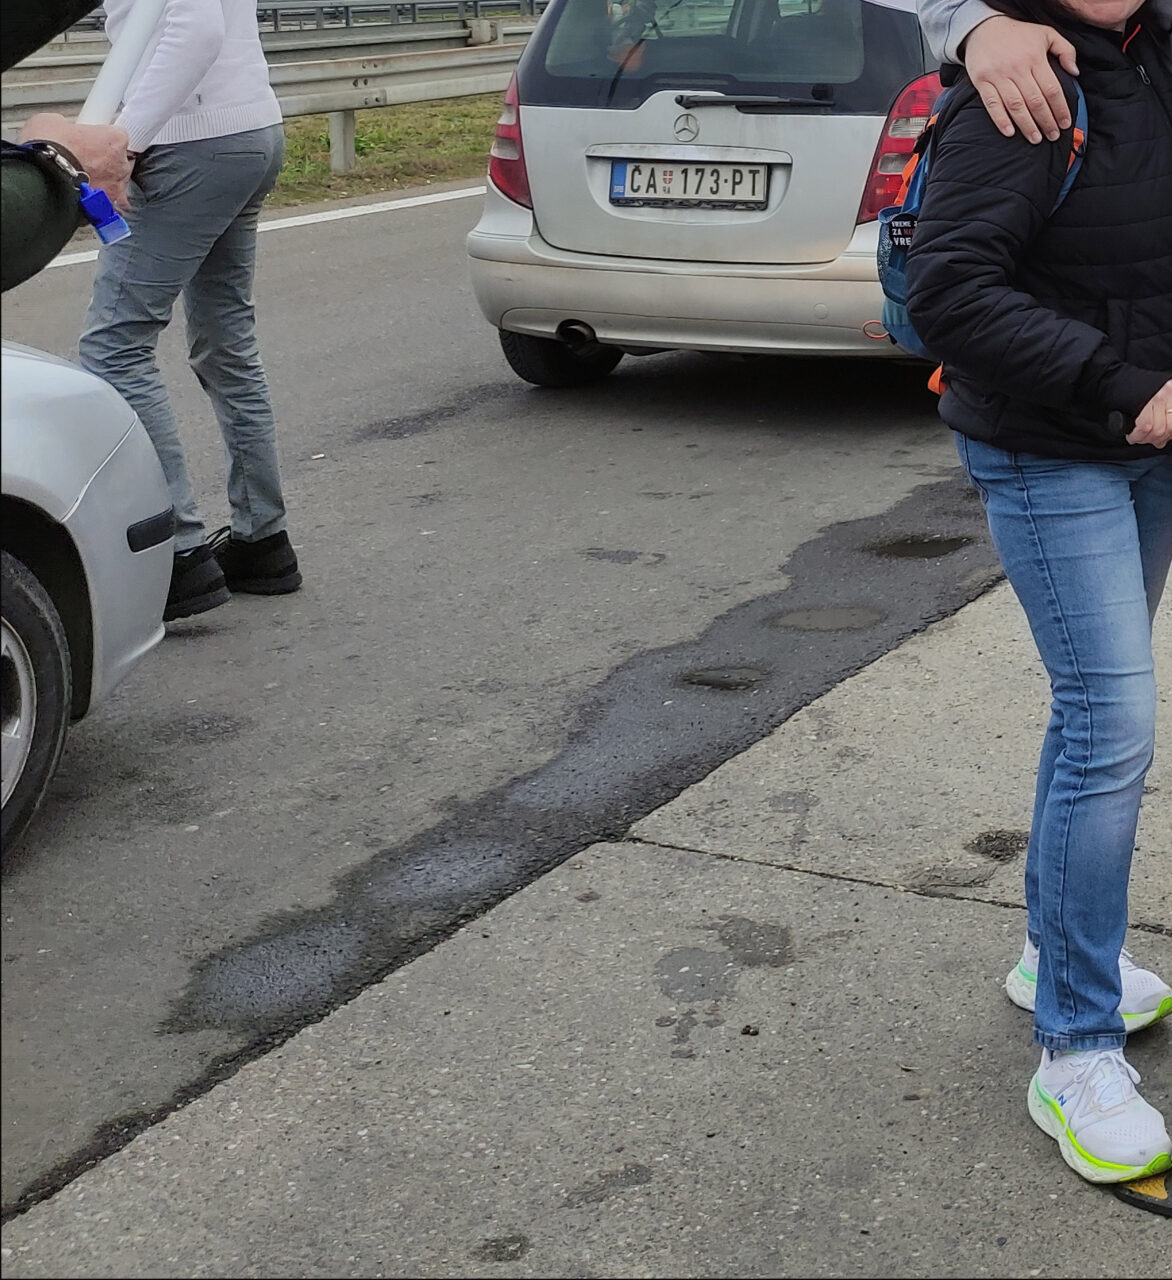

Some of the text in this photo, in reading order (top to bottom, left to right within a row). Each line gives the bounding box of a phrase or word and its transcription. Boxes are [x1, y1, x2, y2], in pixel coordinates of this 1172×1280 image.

[630, 165, 657, 194] ČA
[891, 228, 902, 236] ZA
[893, 237, 912, 246] VRE
